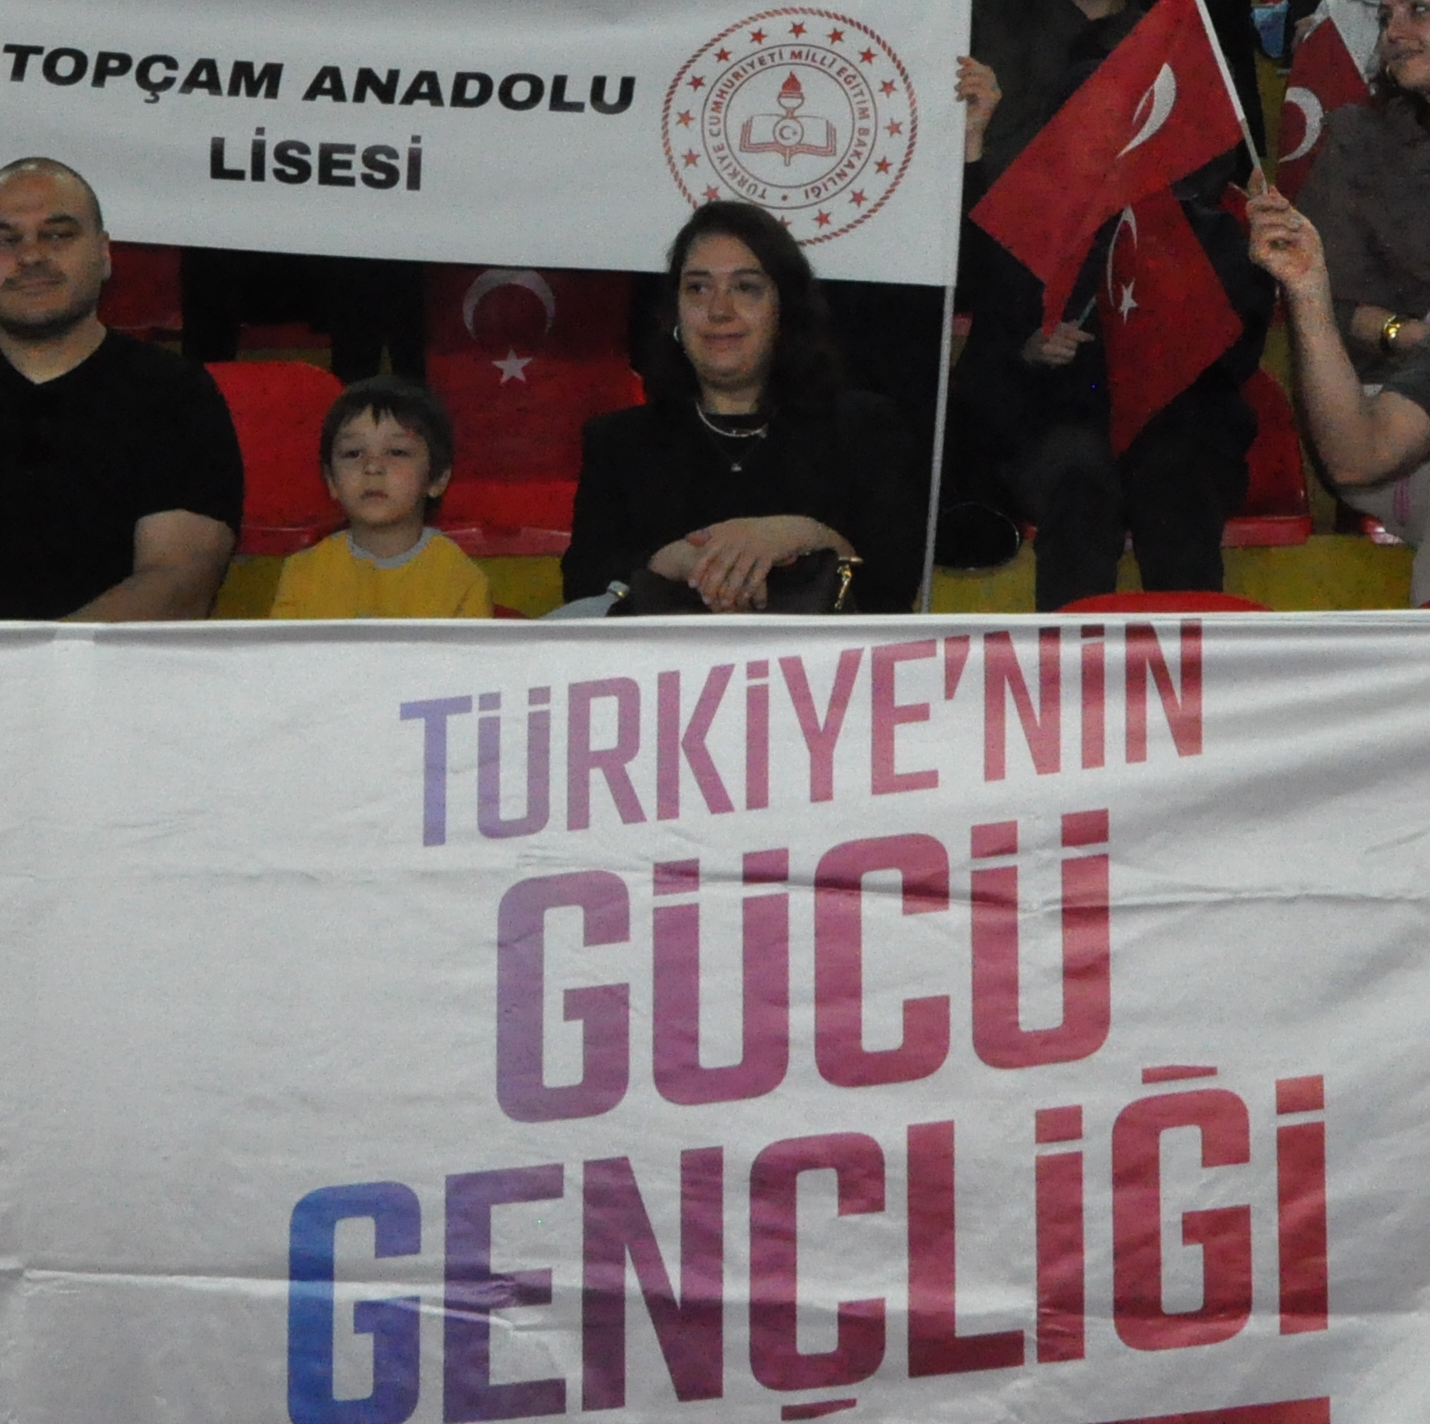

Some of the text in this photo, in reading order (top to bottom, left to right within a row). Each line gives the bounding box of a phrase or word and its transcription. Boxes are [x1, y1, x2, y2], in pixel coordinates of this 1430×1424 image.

[2, 43, 636, 115] TOPÇAM ANADOLU
[708, 48, 784, 138] CUMHURİYETİ
[835, 66, 871, 121] EĞİTİM
[209, 126, 423, 191] LİSESİ
[712, 142, 768, 201] TÜRKİYE
[803, 127, 870, 200] BAKANLIĞI
[399, 616, 1205, 847] TÜRKİYE'NİN
[495, 807, 1112, 1124] GÜCÜ
[286, 1064, 1330, 1424] GENÇLİĞİ
